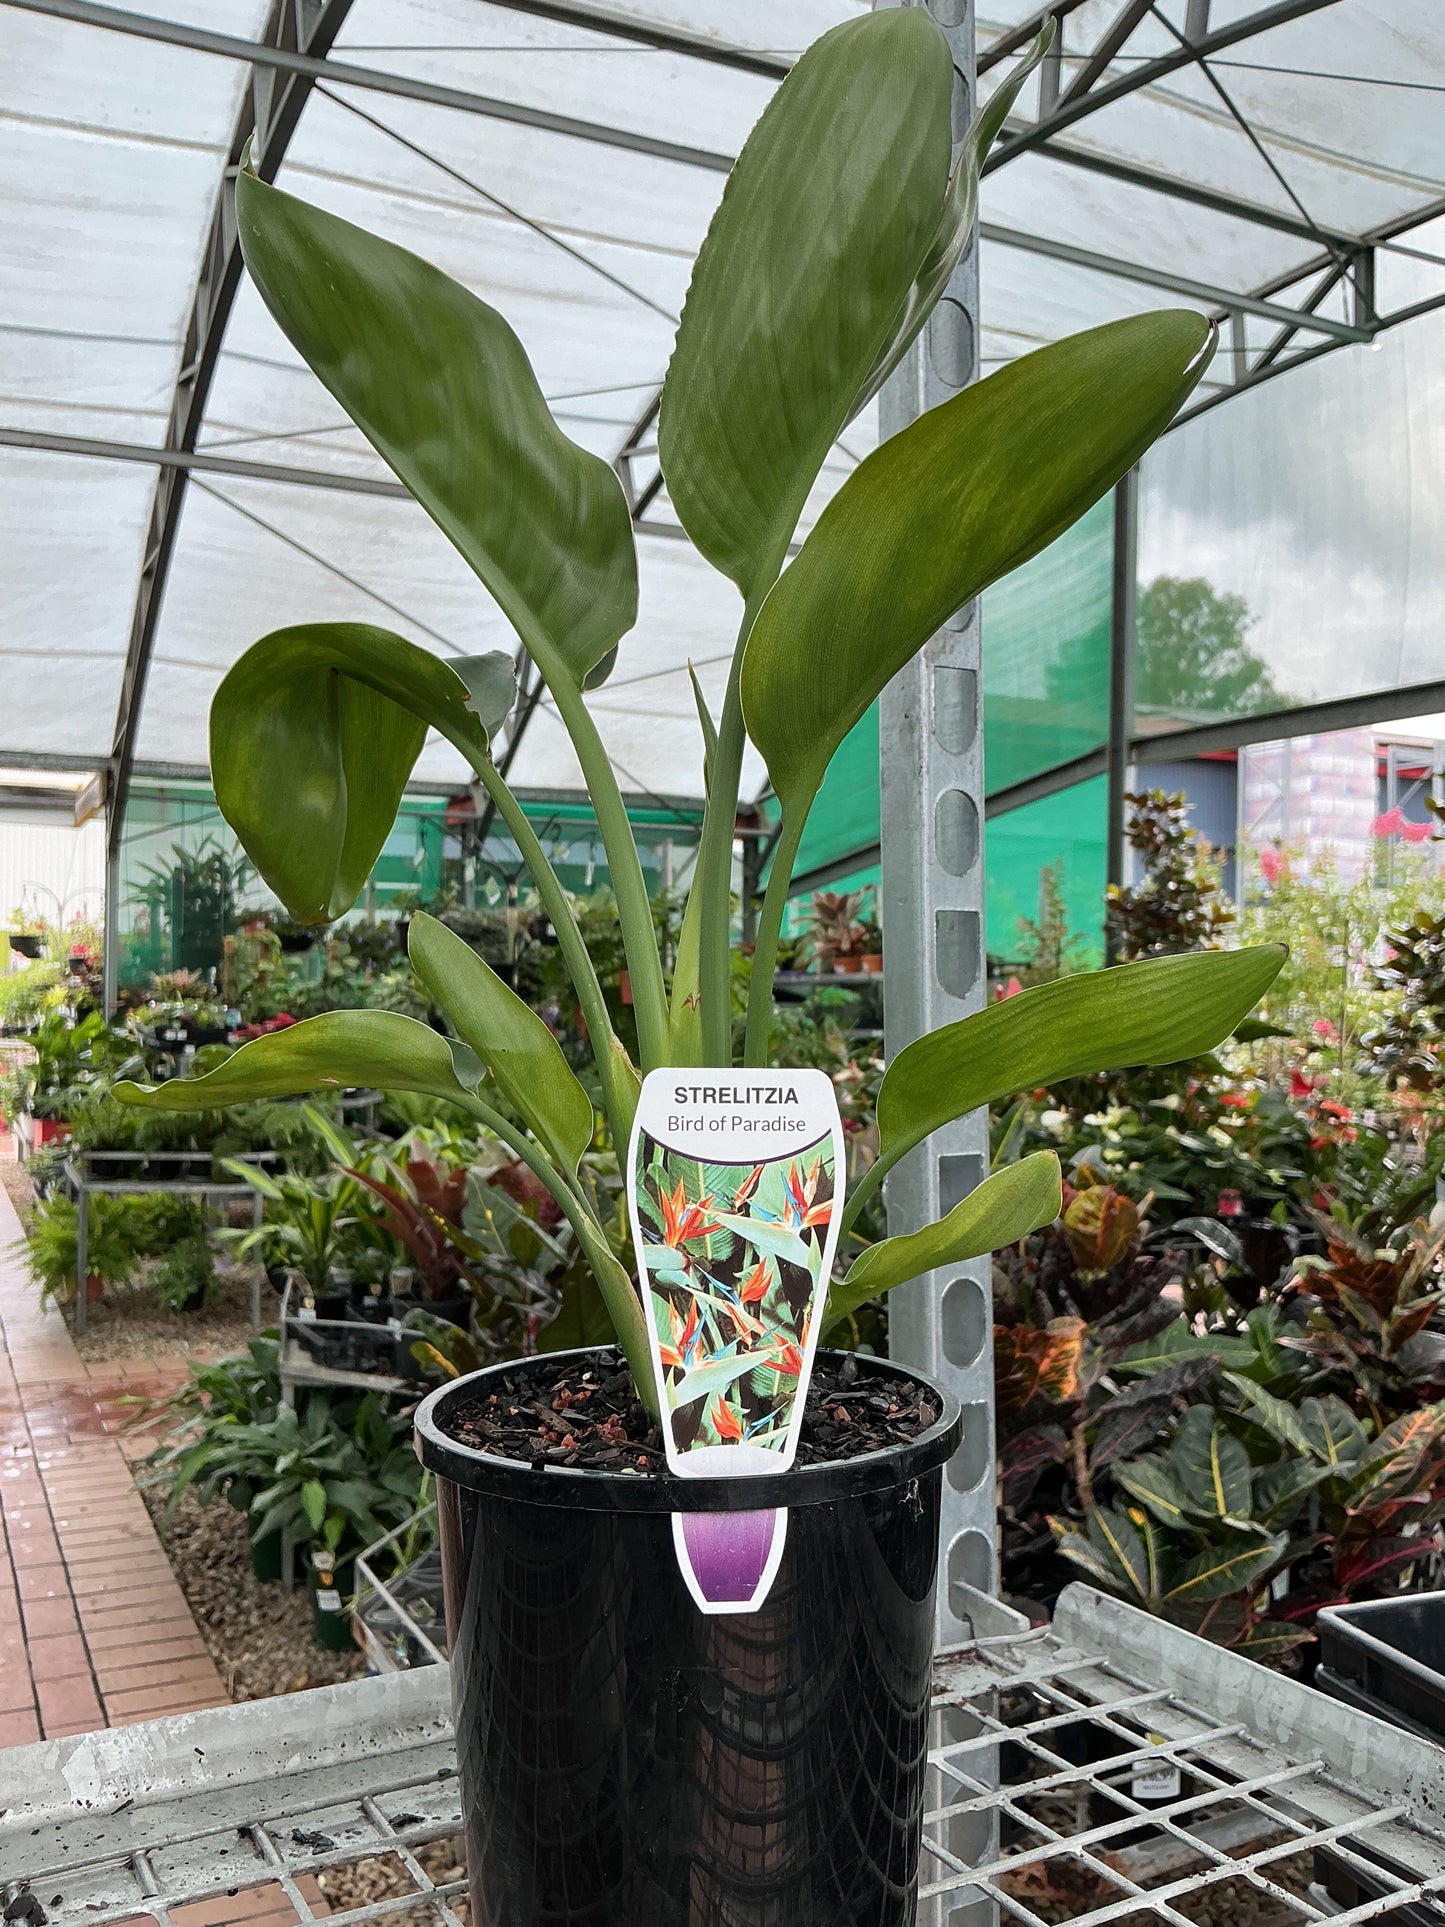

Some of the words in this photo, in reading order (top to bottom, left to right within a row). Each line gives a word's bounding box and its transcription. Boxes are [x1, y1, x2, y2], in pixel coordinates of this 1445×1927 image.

[674, 1086, 799, 1104] STRELITZIA
[668, 1115, 704, 1132] Bird
[708, 1115, 727, 1132] of
[731, 1115, 806, 1132] Paradise
